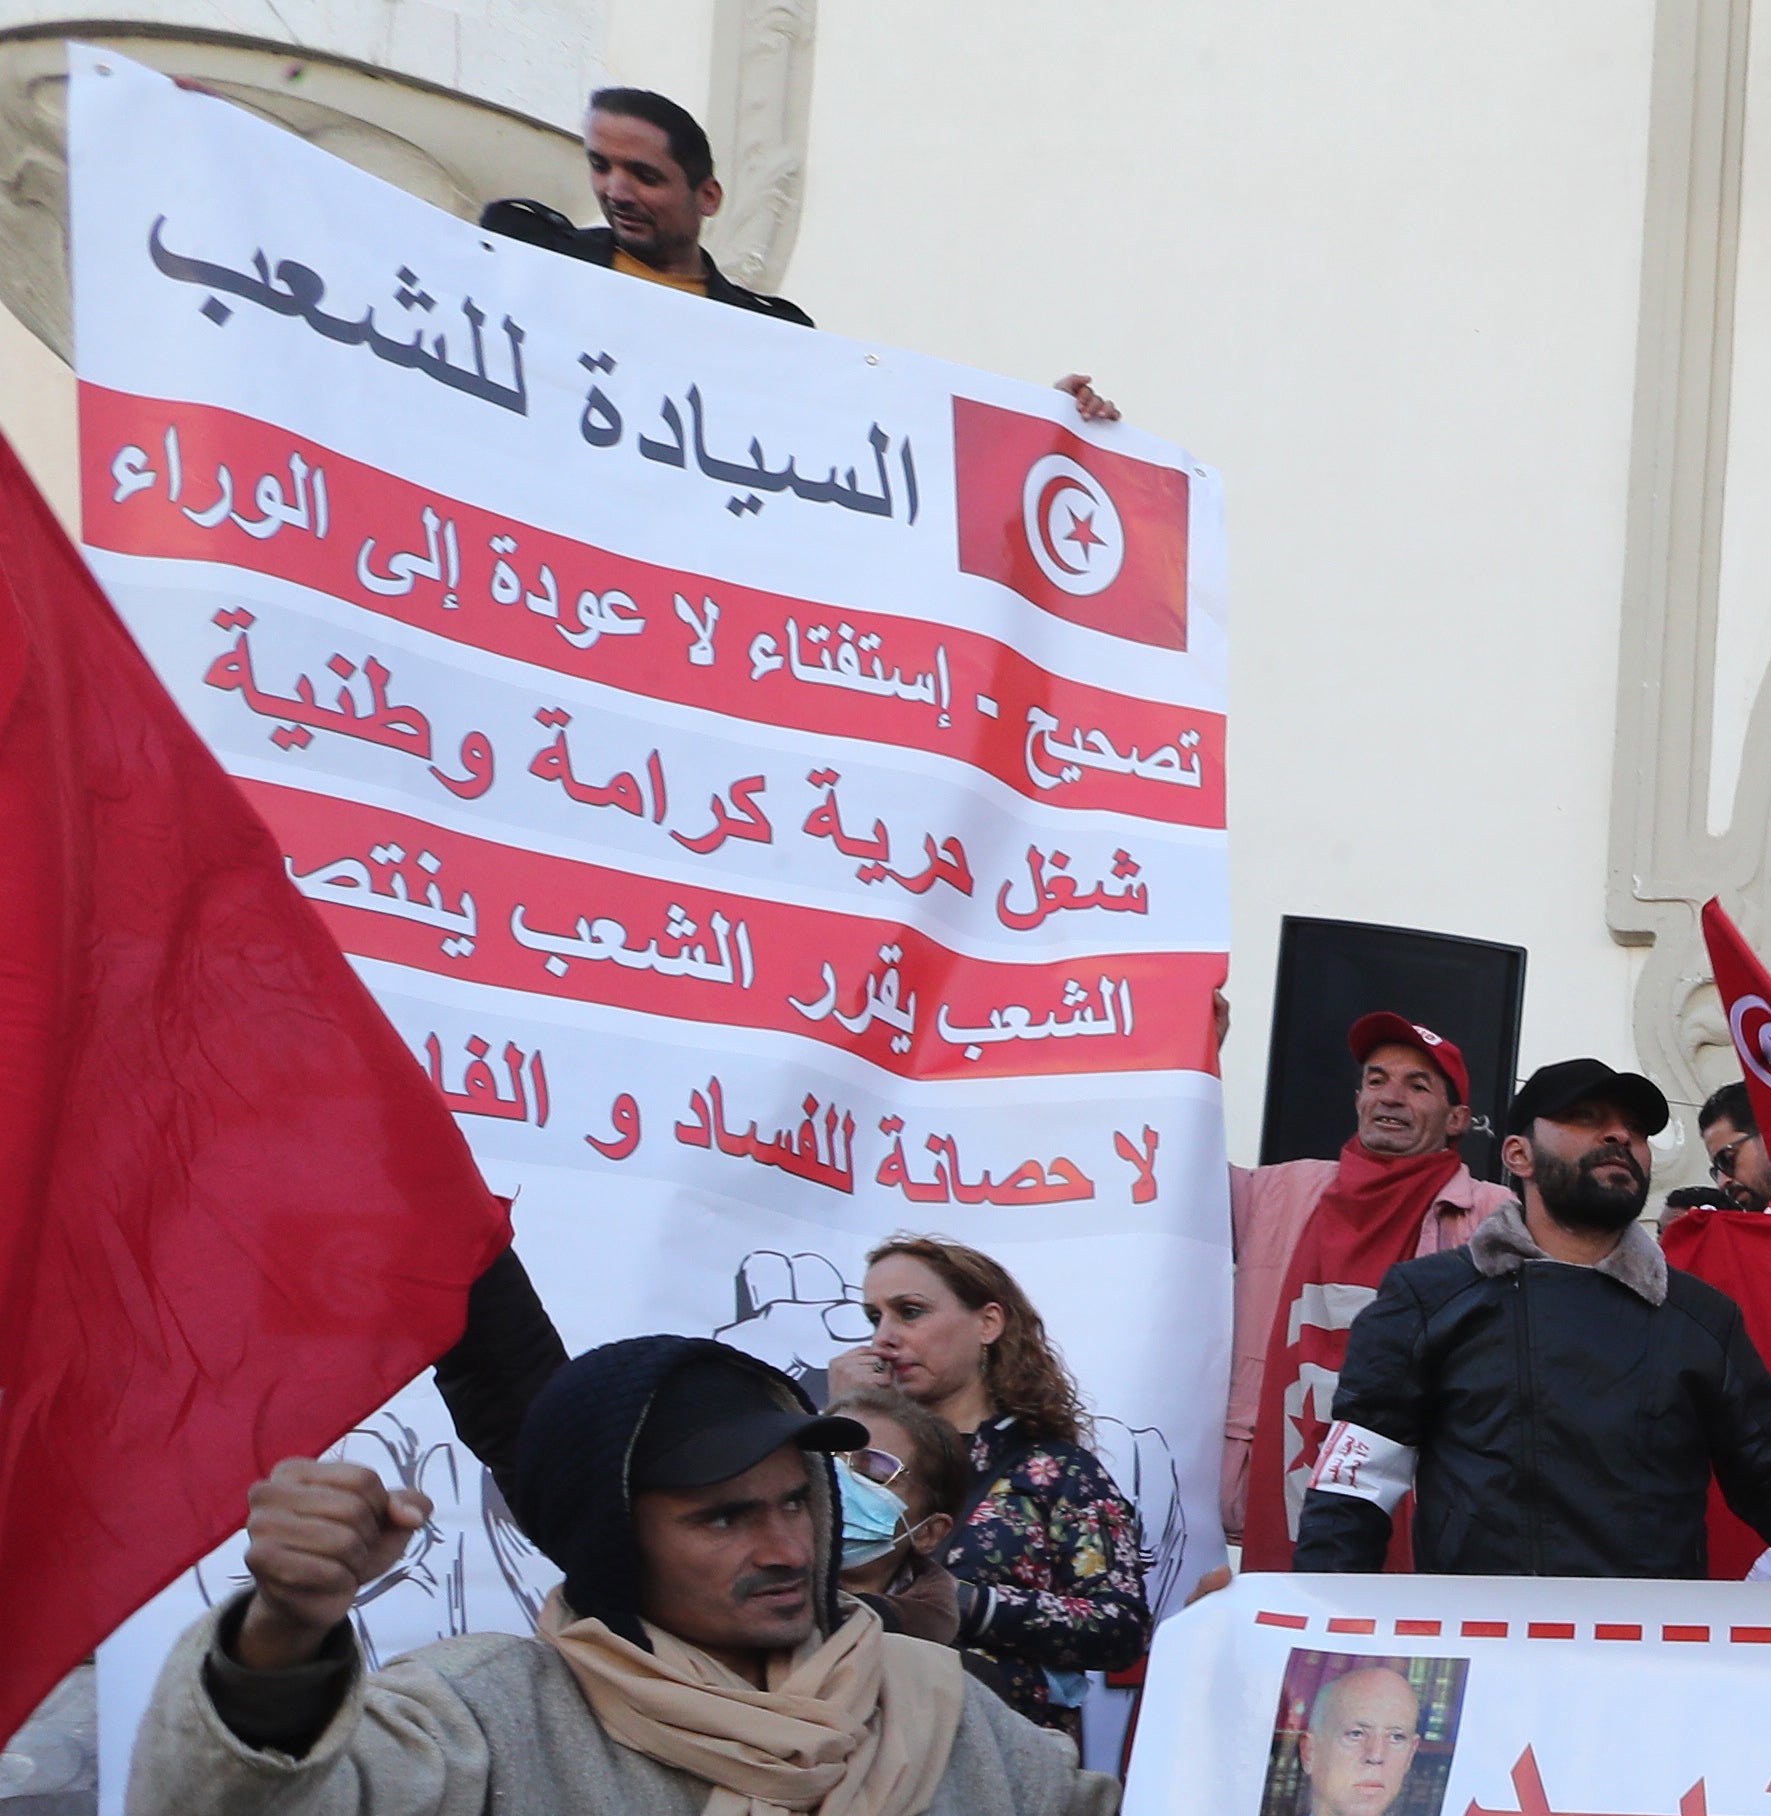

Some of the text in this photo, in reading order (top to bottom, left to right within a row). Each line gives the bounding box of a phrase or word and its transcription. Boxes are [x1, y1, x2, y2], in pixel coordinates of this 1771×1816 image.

[150, 214, 917, 525] السيادة للشعب
[112, 427, 327, 538] الوراء
[358, 507, 458, 608] إلى
[490, 536, 645, 648] عودة
[675, 594, 719, 665] لا
[750, 617, 951, 727] إستفتاء
[207, 608, 1146, 929] شغل حرية كرامة وطنية
[1026, 707, 1201, 789] تصحيح
[284, 844, 1132, 1060] الشعب يقرر الشعب ينتص
[424, 1035, 1157, 1205] لا حصانة للفساد و الفا
